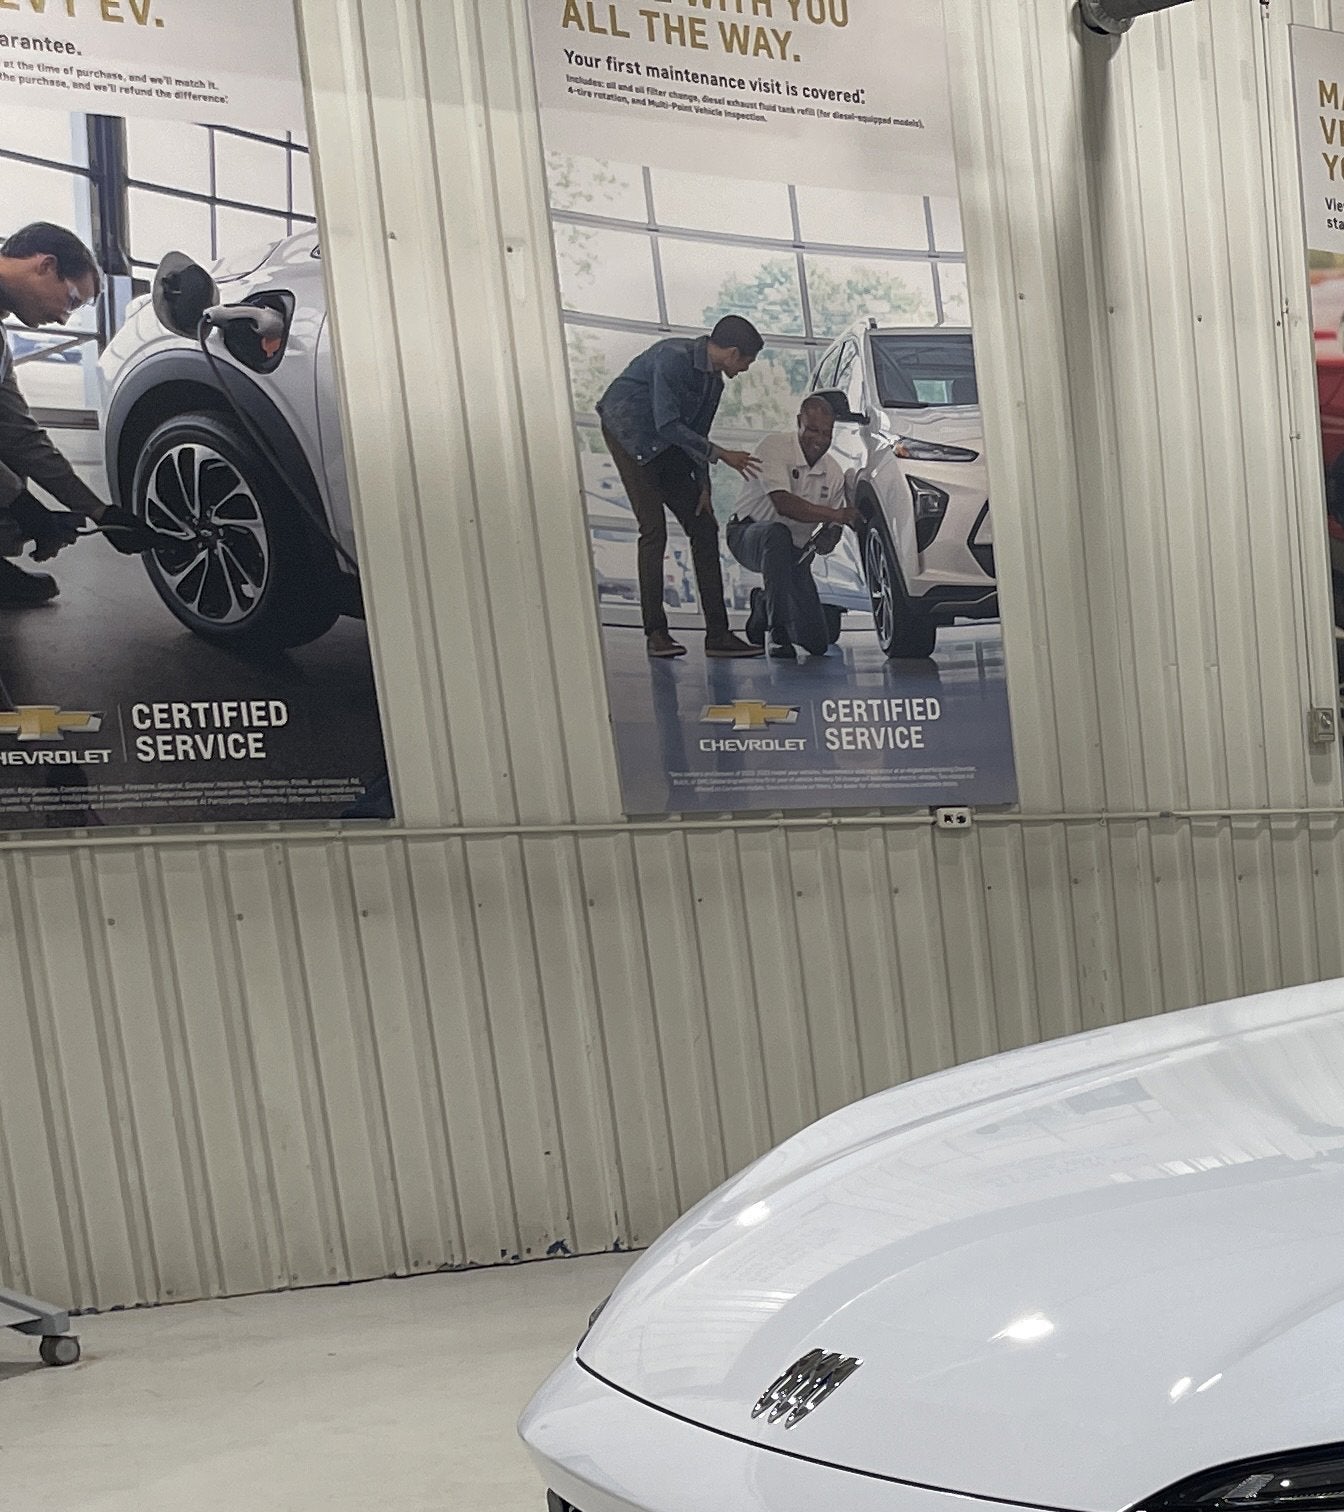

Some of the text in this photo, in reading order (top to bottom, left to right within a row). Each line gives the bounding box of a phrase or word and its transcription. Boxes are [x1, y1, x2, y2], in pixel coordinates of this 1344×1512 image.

[562, 0, 631, 39] ALL
[639, 9, 709, 50] THE
[718, 21, 801, 62] WAY.
[563, 49, 602, 69] Your
[606, 56, 642, 75] first
[646, 65, 746, 91] maintenance
[750, 77, 782, 95] visit
[785, 80, 799, 96] is
[131, 700, 289, 730] CERTIFIED
[822, 697, 942, 723] CERTIFIED
[136, 732, 267, 763] SERVICE
[699, 738, 808, 752] CHEVROLET
[825, 726, 925, 751] SERVICE
